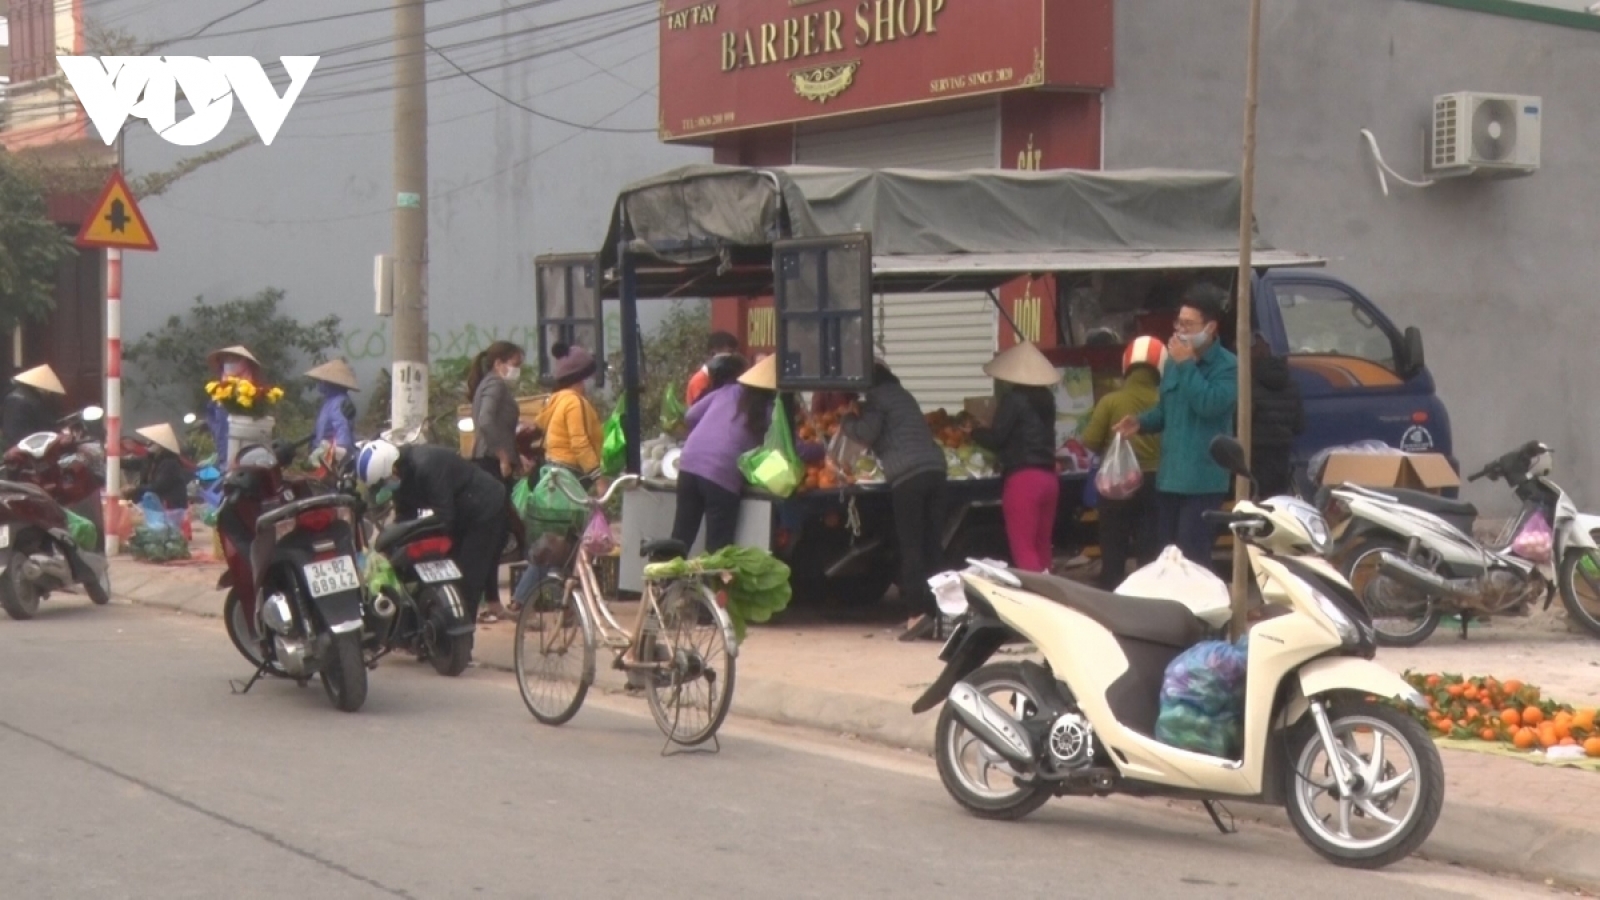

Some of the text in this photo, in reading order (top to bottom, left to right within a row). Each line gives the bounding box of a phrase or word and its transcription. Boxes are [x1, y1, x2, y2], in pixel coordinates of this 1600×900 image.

[721, 0, 945, 71] BARBER SHOP
[930, 76, 965, 93] SERVING
[968, 70, 993, 86] SINCE
